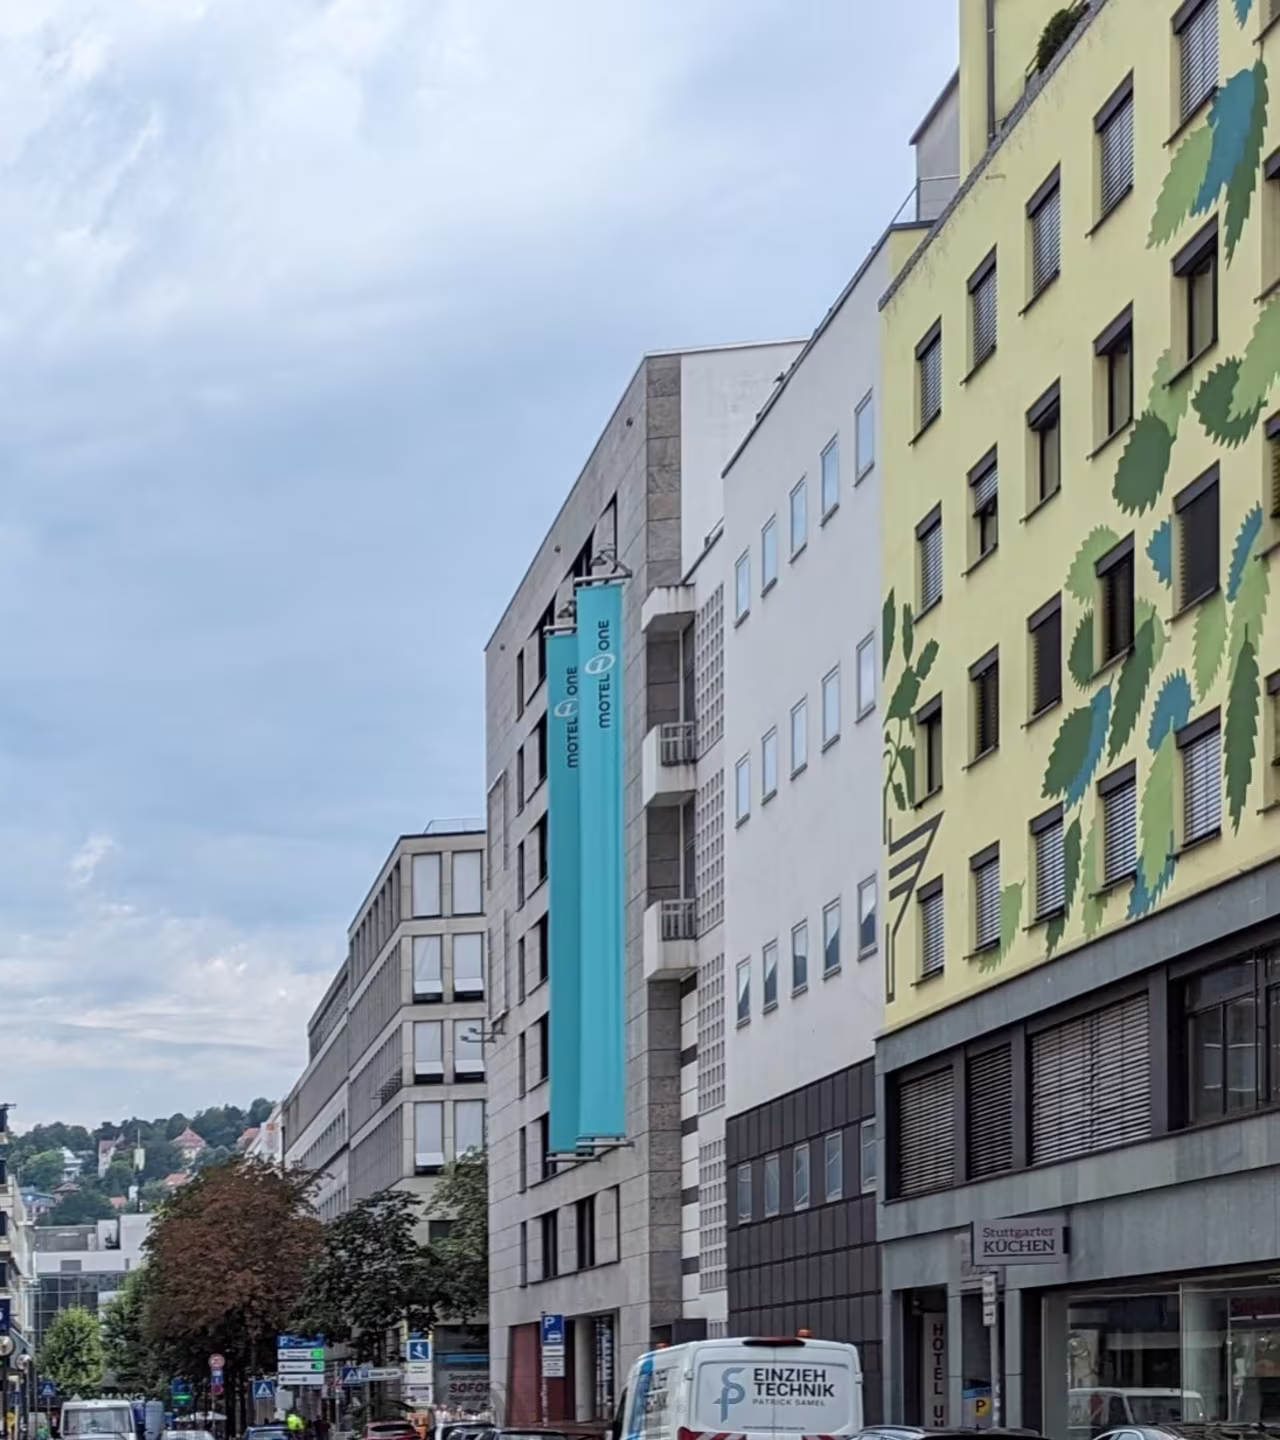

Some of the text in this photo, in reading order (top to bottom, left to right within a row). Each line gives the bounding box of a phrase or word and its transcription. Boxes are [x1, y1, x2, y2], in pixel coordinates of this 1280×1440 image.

[983, 1227, 1055, 1240] Stuttgarter
[983, 1238, 1055, 1253] KÜCHEN
[544, 1316, 555, 1328] P
[933, 1323, 944, 1395] HOTEL
[753, 1367, 827, 1383] EINZIEH
[753, 1382, 836, 1397] TECHNIK
[752, 1398, 792, 1406] PATRICK
